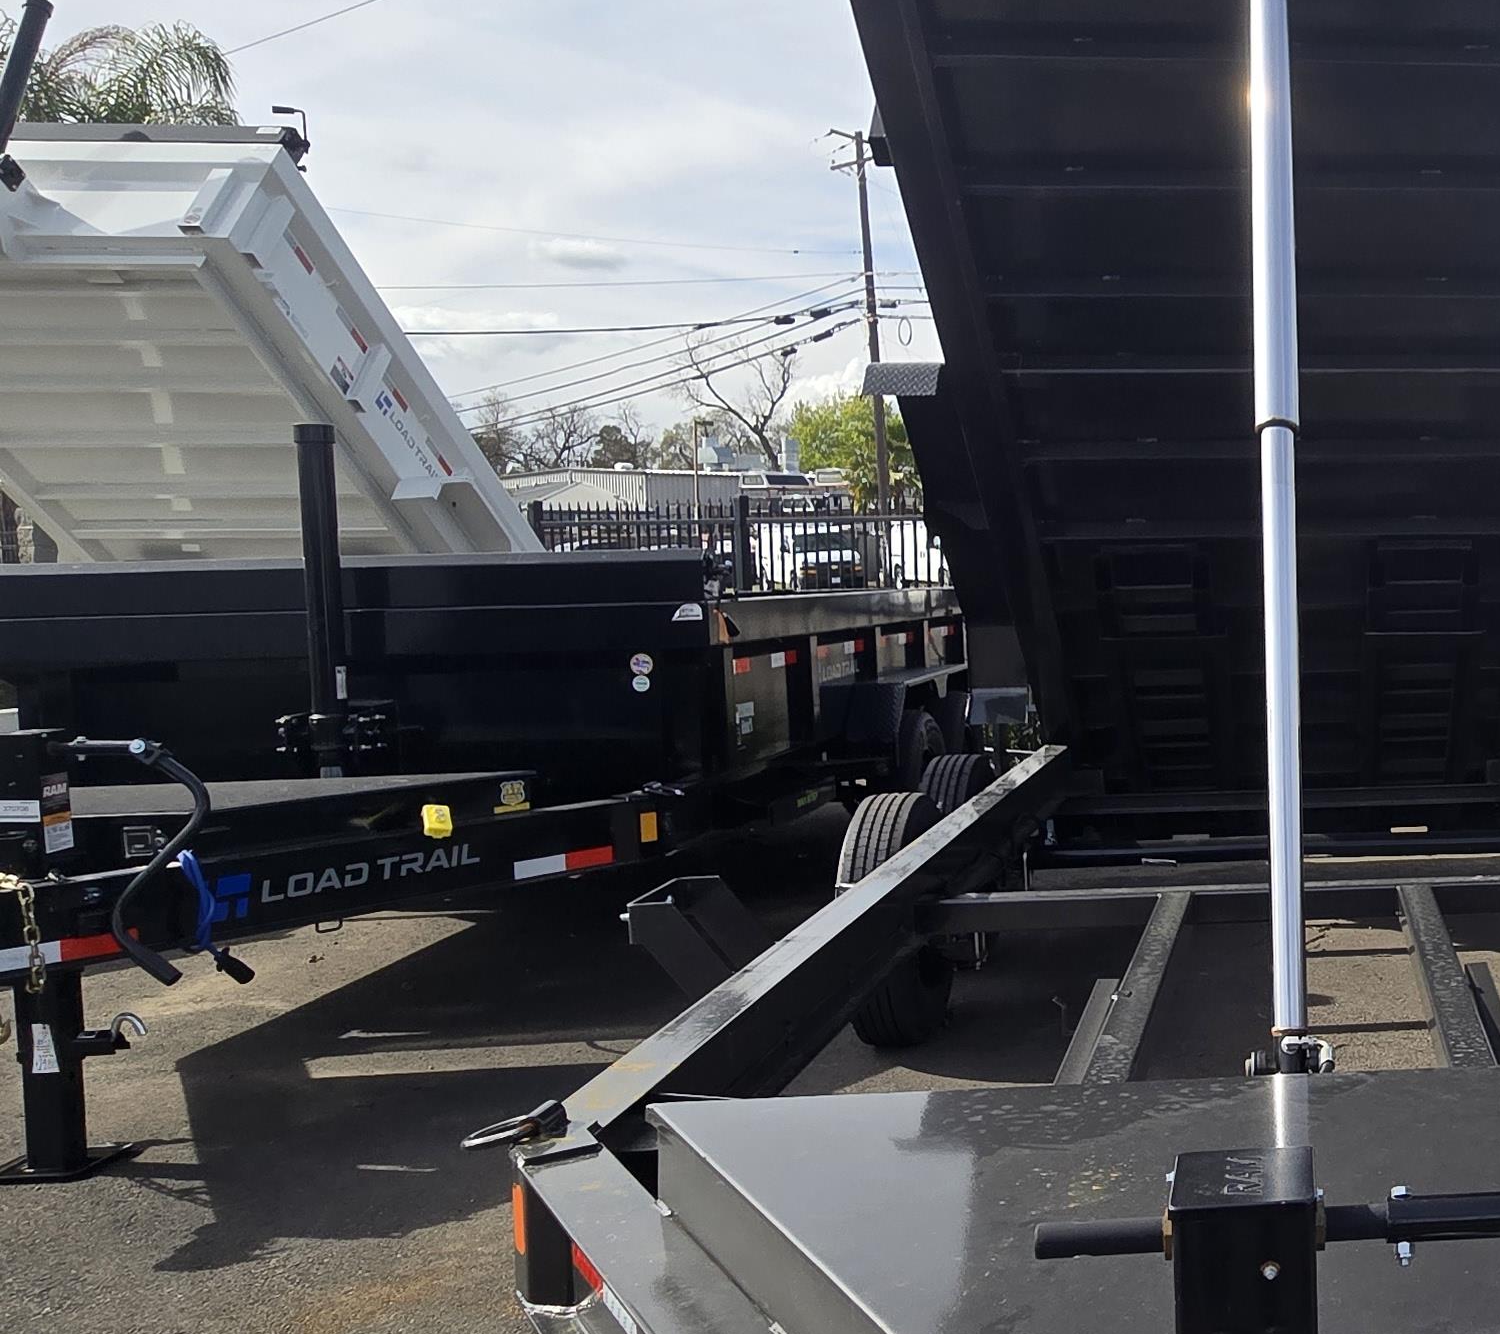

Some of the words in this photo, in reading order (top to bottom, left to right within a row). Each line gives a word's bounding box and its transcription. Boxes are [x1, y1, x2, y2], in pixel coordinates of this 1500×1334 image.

[389, 412, 416, 449] LOAD
[414, 444, 438, 478] TRAI
[42, 783, 67, 798] RAM
[260, 862, 370, 903] LOAD
[376, 843, 481, 881] TRAIL
